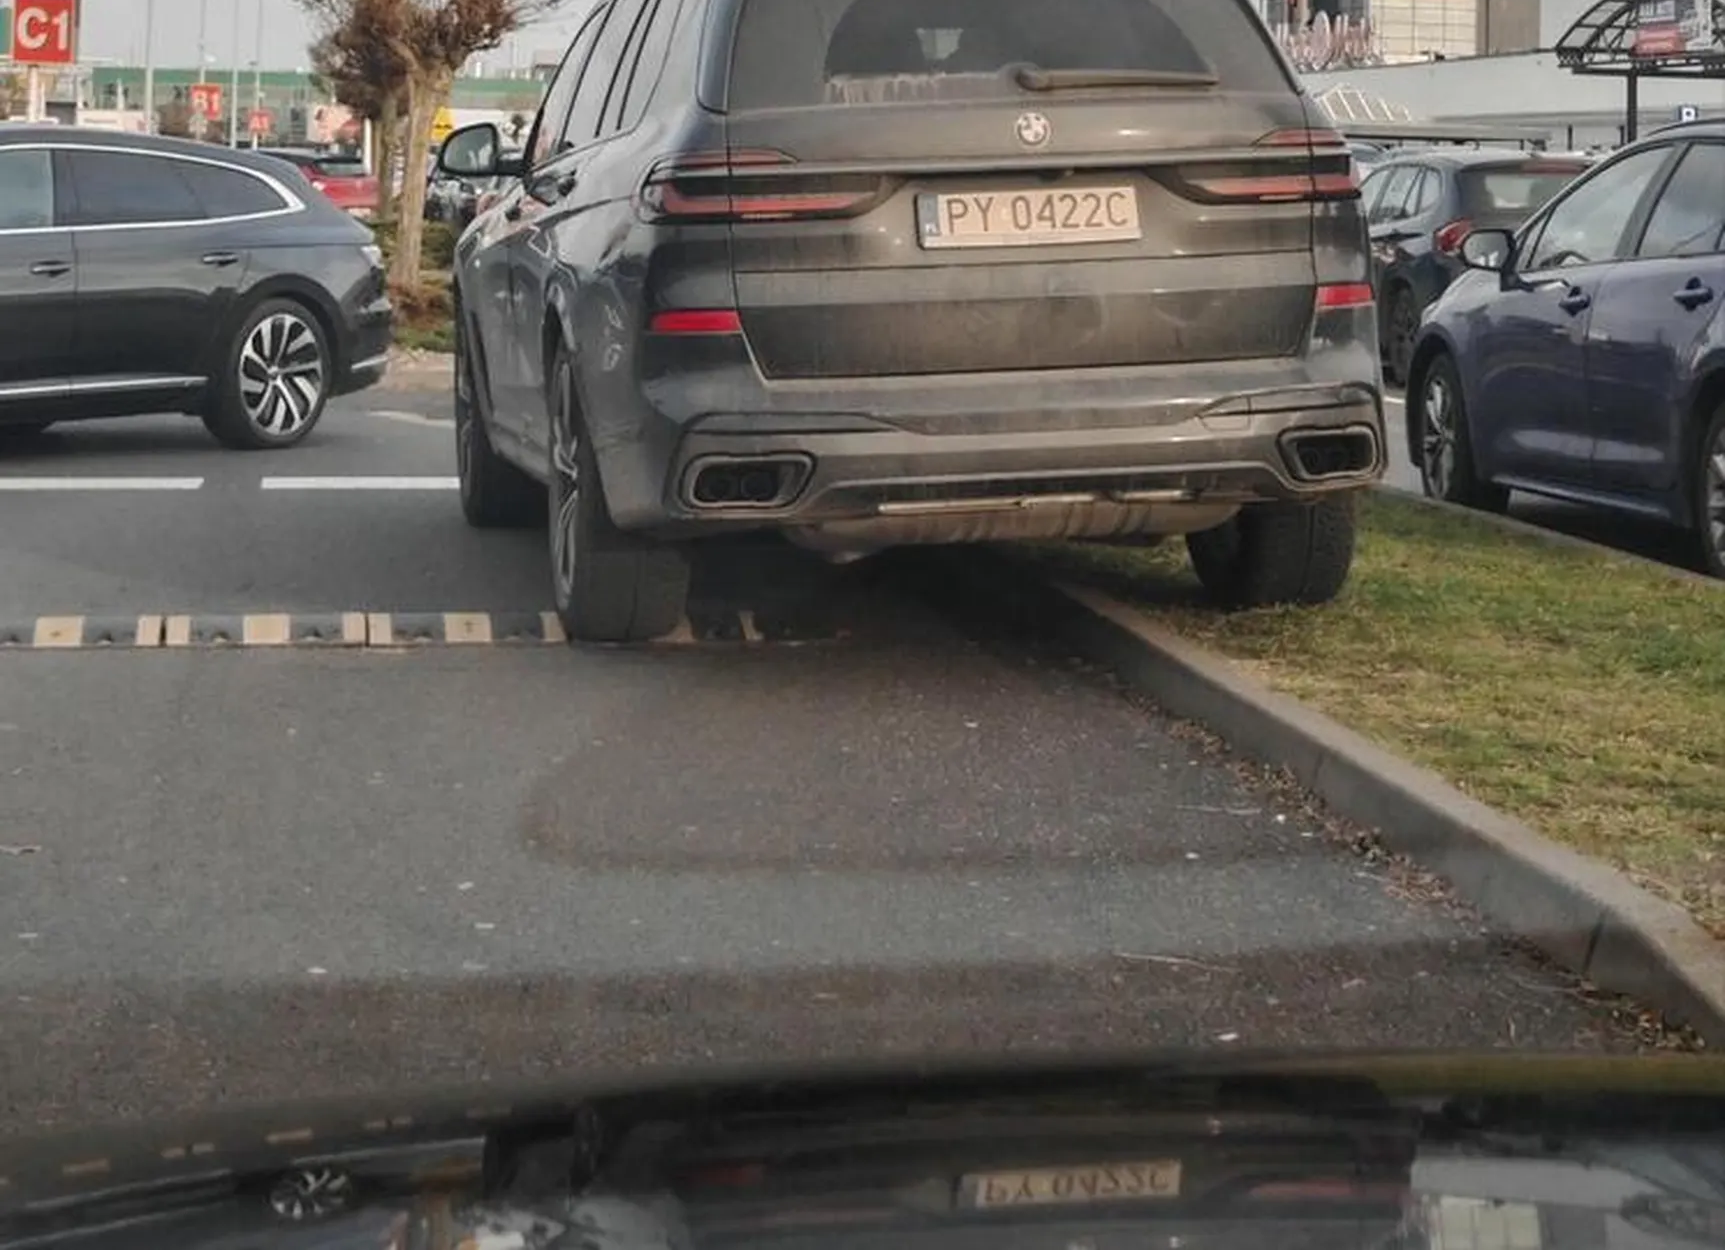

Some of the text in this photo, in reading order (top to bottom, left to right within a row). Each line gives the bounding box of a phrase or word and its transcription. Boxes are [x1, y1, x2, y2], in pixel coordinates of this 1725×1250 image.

[18, 6, 68, 51] C1
[192, 90, 220, 111] B1
[946, 191, 1128, 233] PY 0422C
